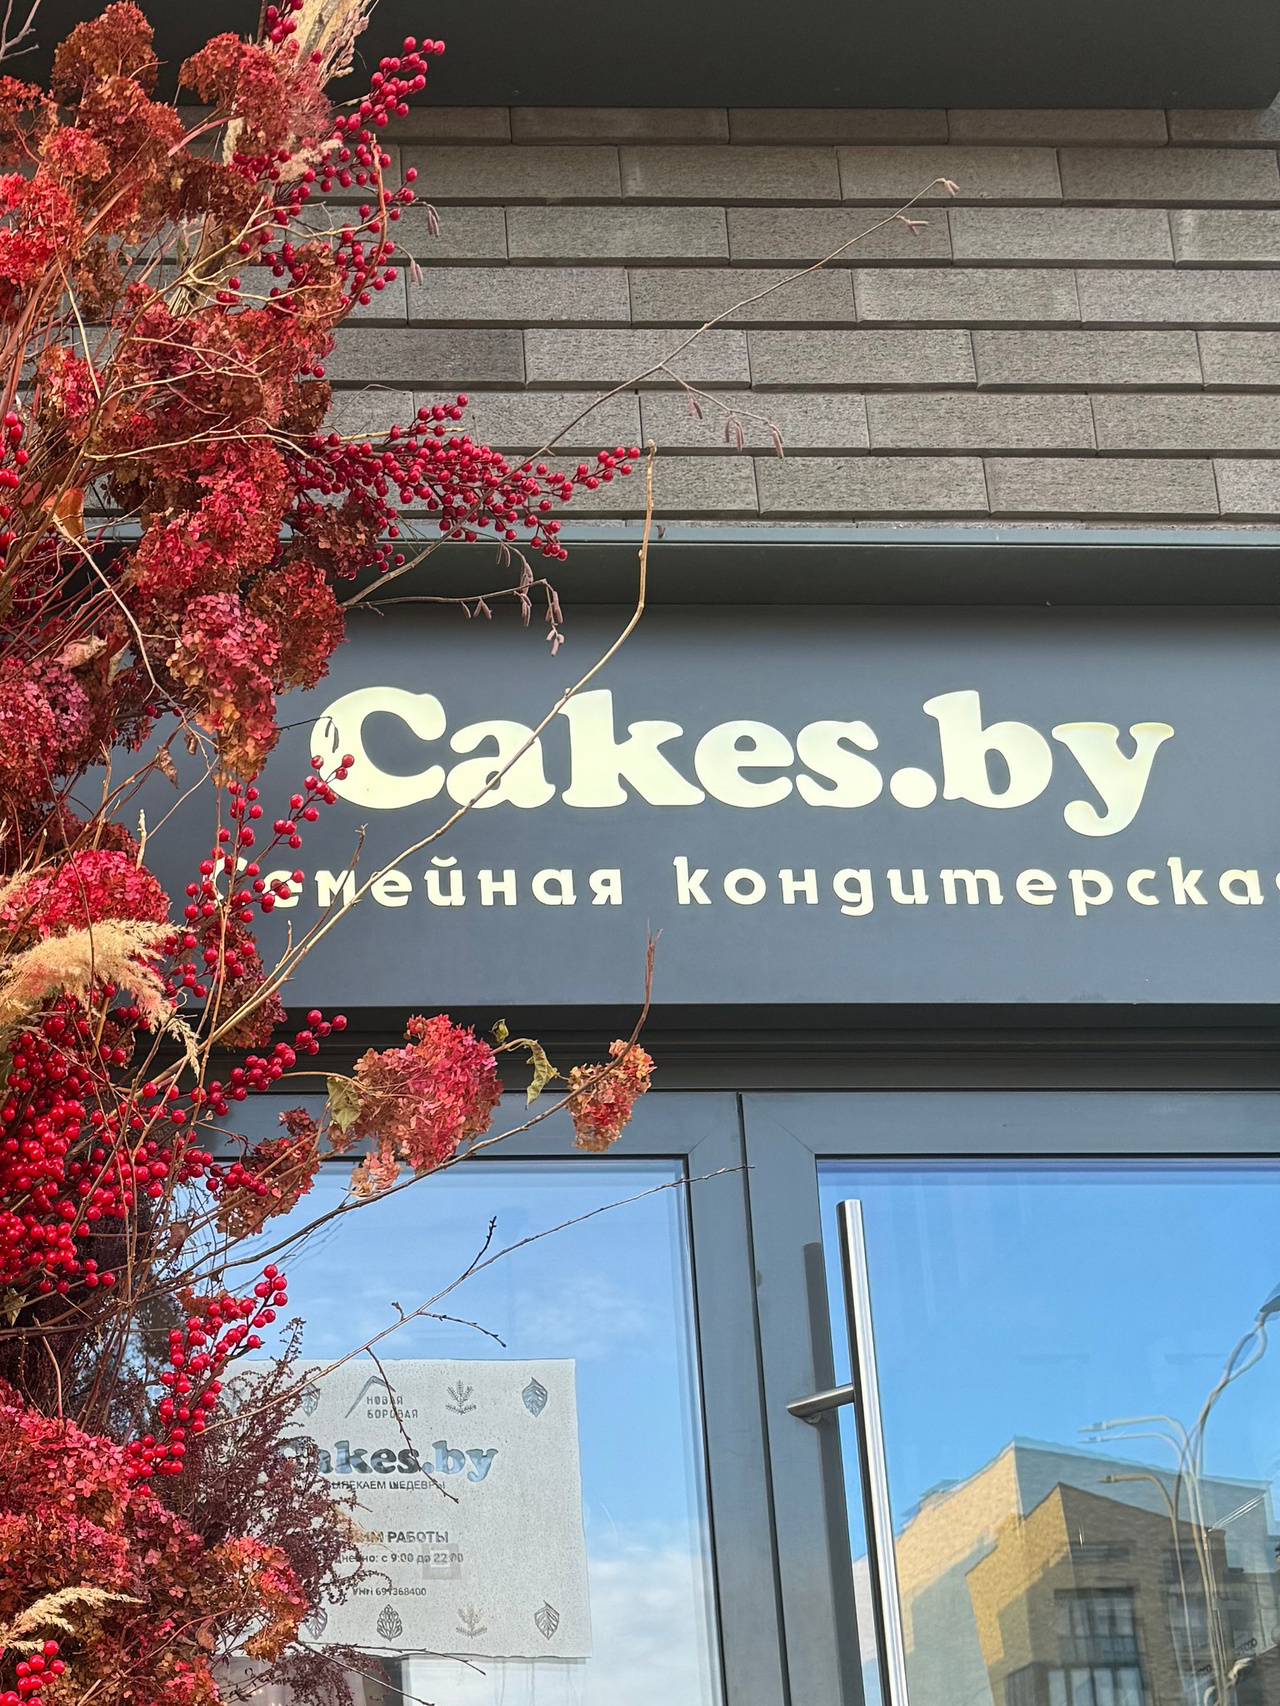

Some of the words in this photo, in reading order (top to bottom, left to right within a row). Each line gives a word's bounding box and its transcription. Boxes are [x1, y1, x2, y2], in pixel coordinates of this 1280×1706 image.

[310, 686, 1175, 837] Cakes.by
[672, 856, 1280, 917] кондитерска
[387, 1531, 449, 1543] РАБОТЫ
[390, 1553, 414, 1563] 9:00
